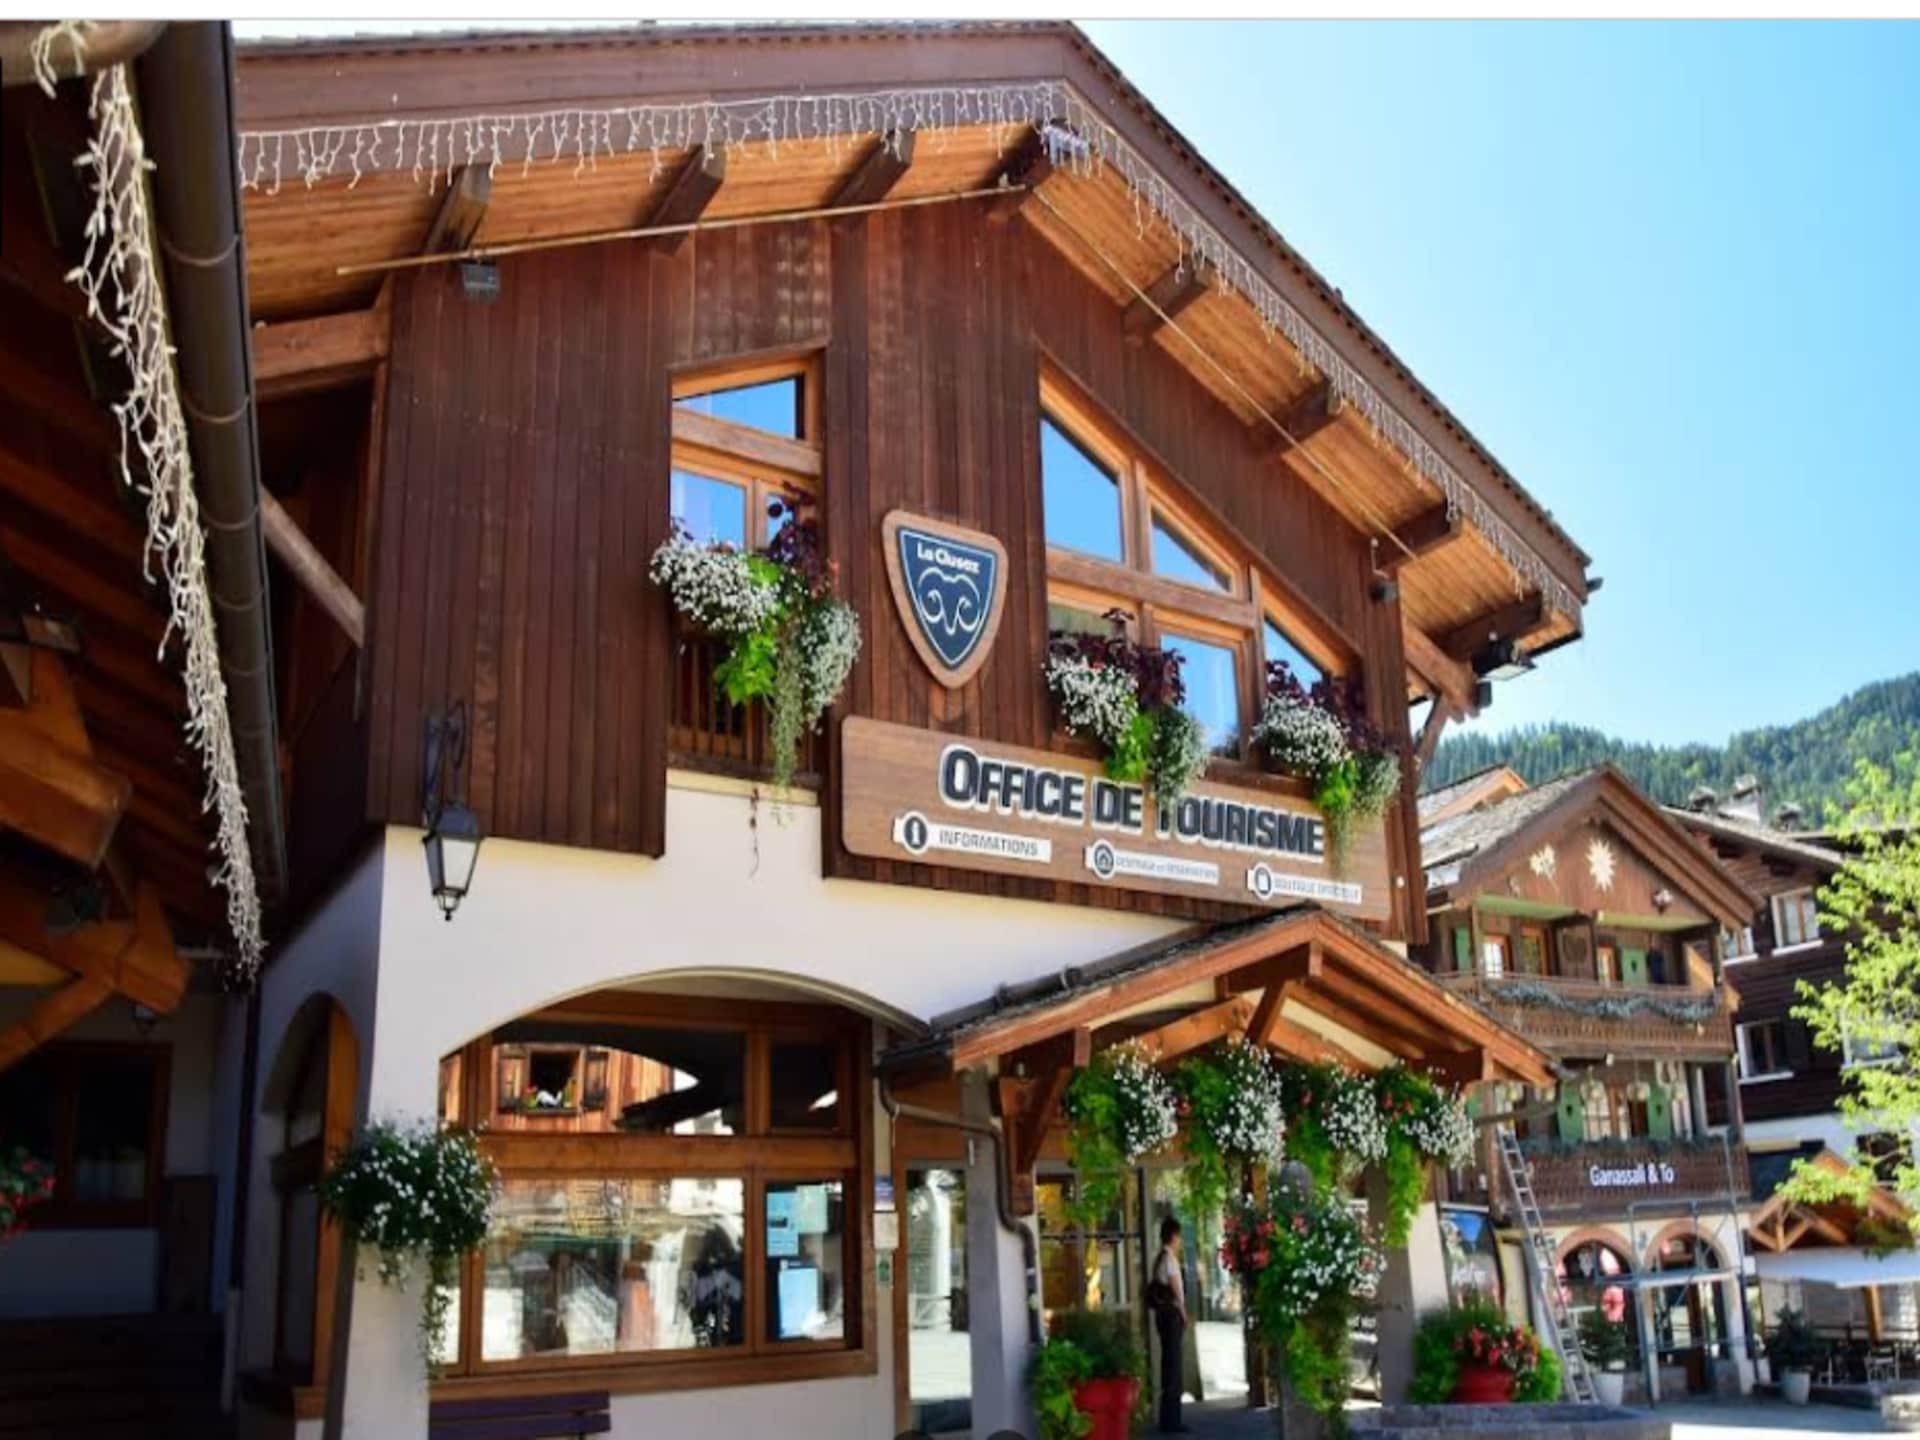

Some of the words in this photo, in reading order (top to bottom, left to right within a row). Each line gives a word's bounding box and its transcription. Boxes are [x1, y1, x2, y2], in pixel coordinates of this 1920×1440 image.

[917, 542, 934, 561] La
[942, 747, 1085, 822] OFFICE
[1093, 779, 1143, 832] DE
[938, 829, 1039, 857] INFORMATIONS
